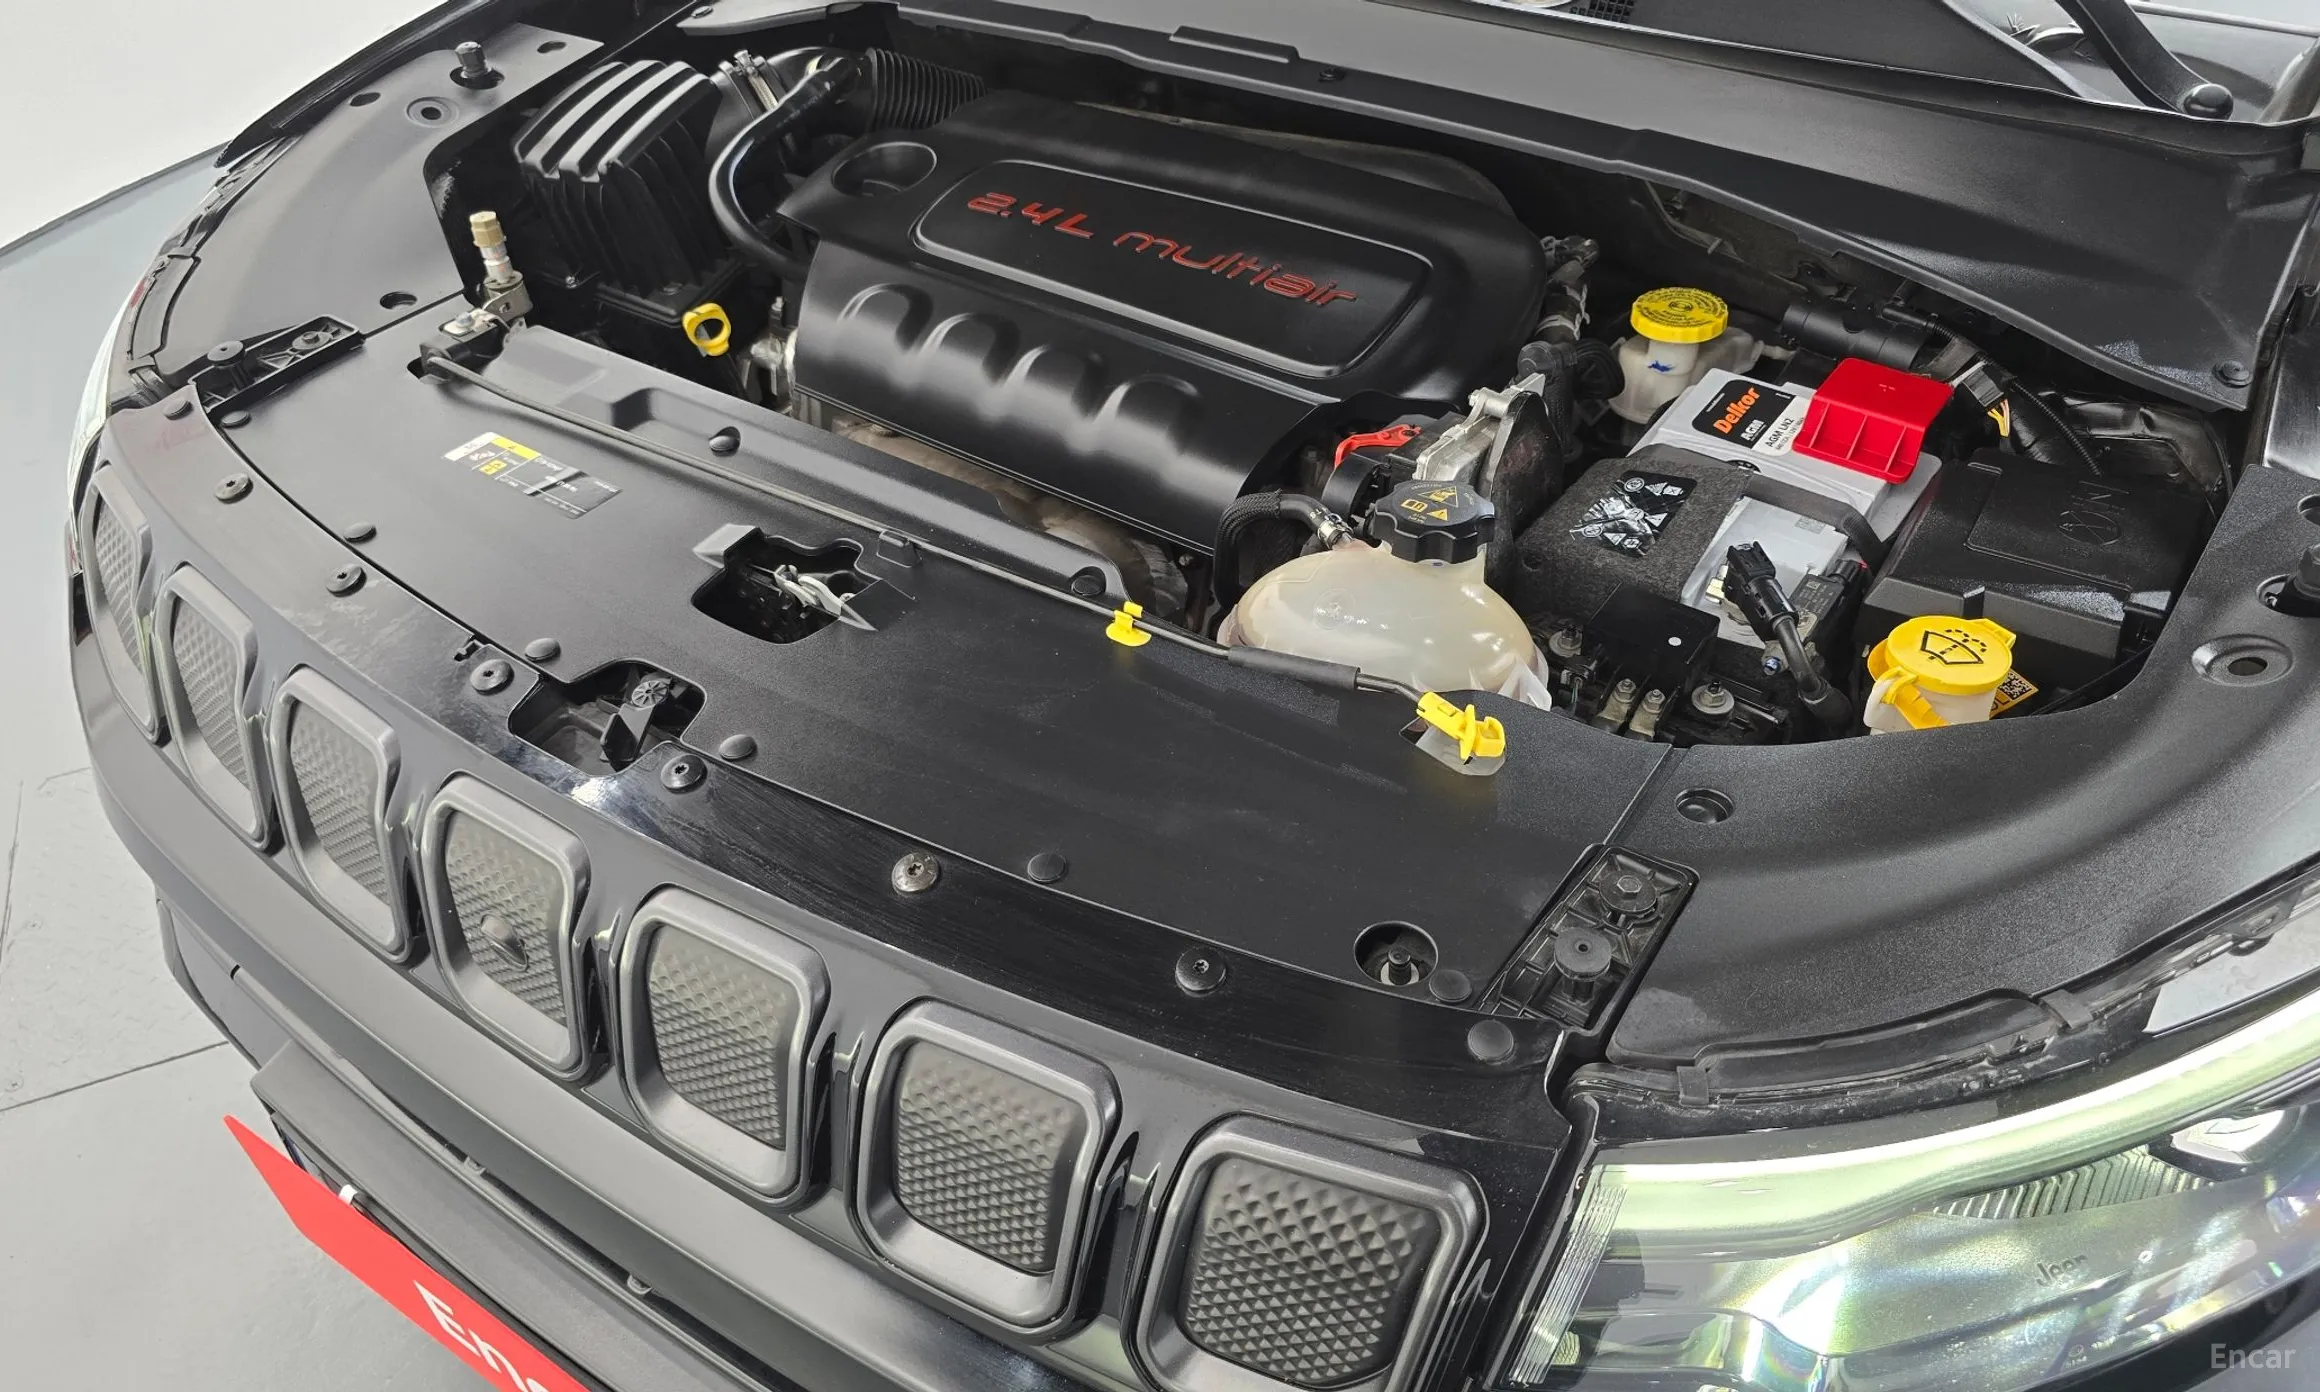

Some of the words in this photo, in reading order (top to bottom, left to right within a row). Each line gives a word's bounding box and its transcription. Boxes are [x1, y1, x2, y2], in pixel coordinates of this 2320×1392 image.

[967, 192, 1094, 239] 2.4L
[1113, 231, 1357, 306] multiair
[1713, 386, 1761, 434] Delkor
[1740, 419, 1765, 441] AGM
[1765, 430, 1784, 448] AGM
[1778, 418, 1794, 431] LN2
[413, 1280, 551, 1392] En
